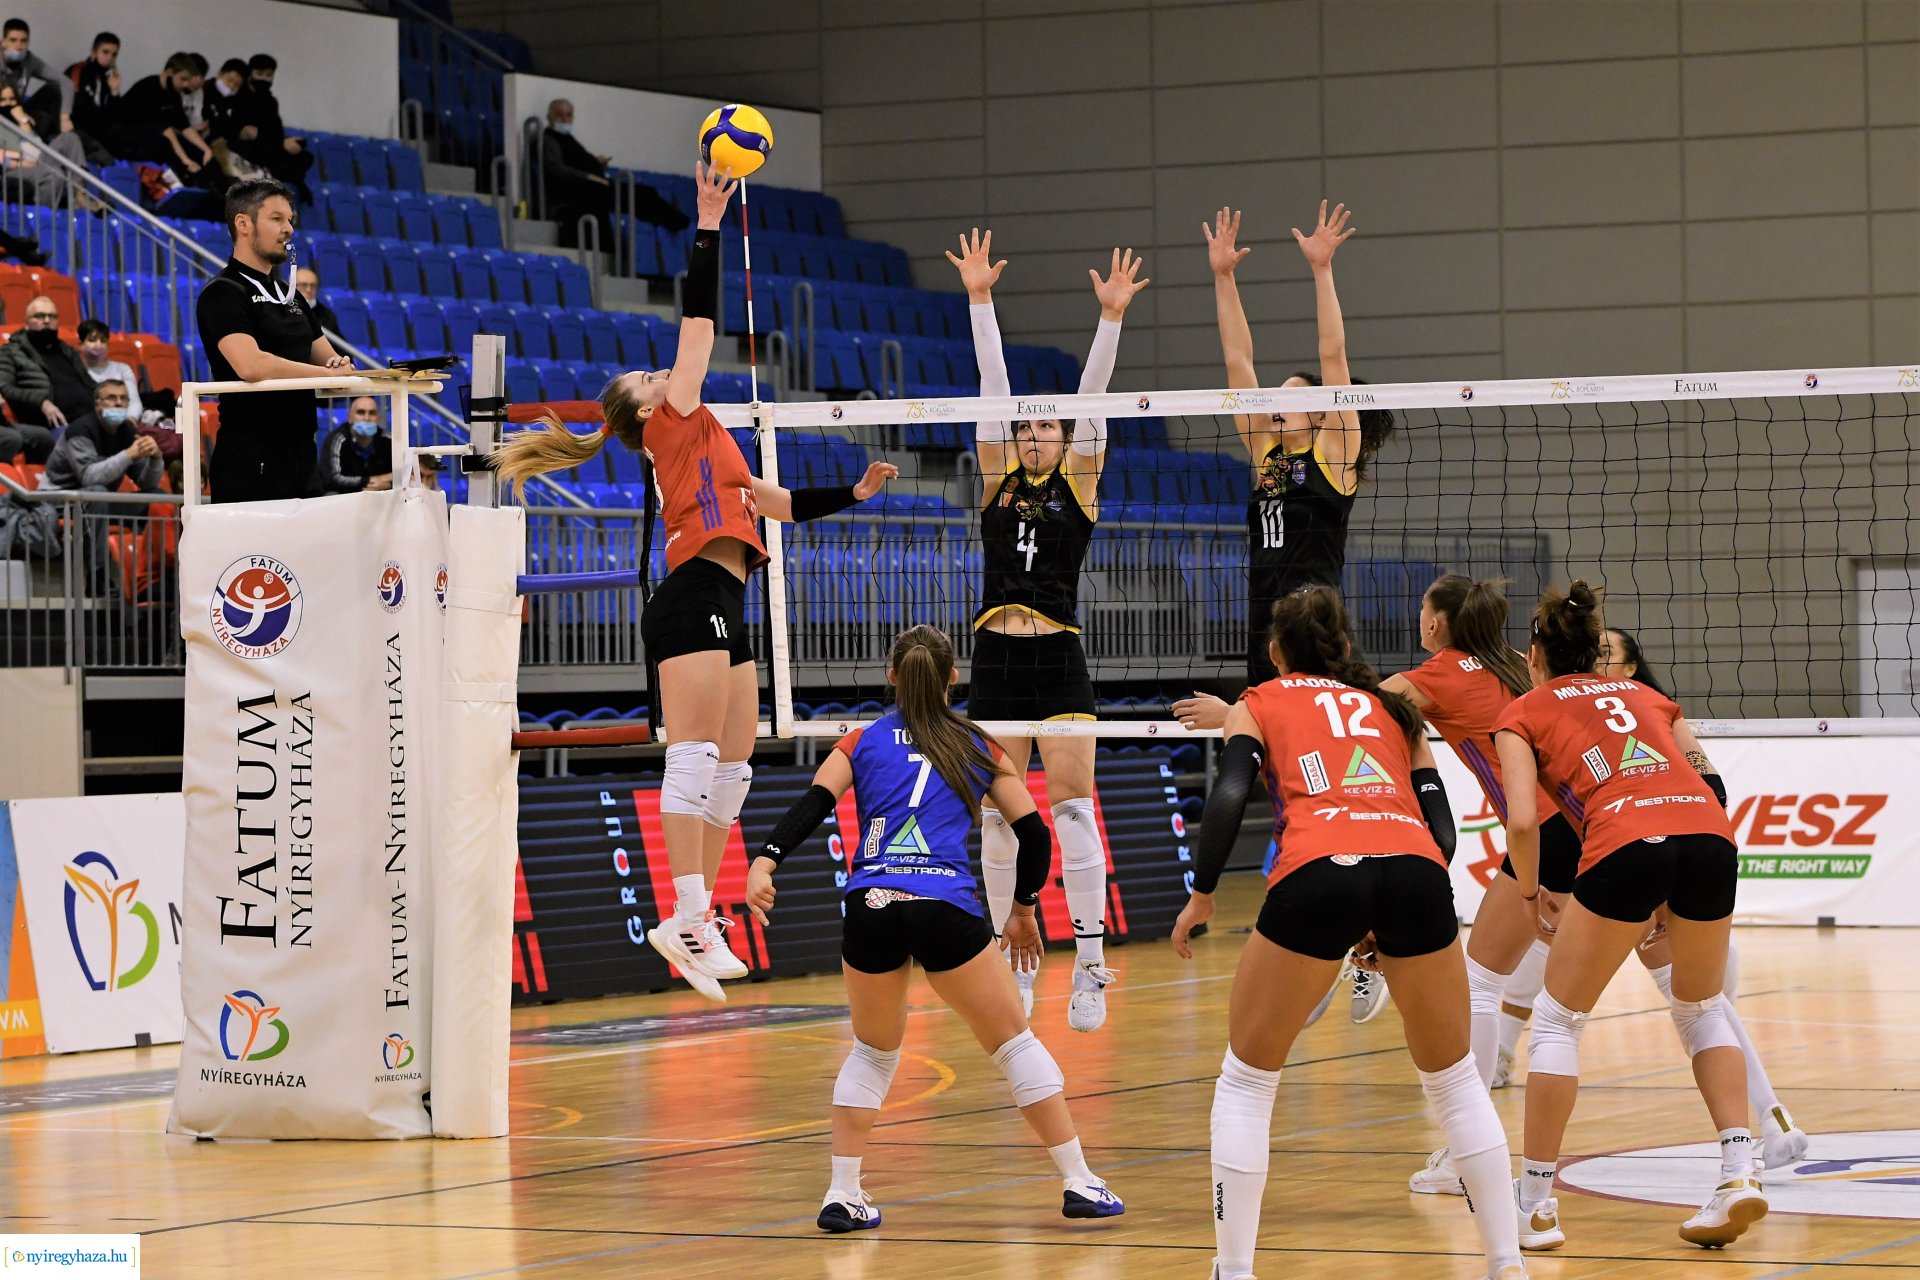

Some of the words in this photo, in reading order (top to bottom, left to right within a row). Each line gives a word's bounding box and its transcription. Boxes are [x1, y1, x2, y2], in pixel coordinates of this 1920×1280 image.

[1674, 379, 1718, 392] FATUM
[1016, 400, 1057, 414] FATUM
[1333, 391, 1376, 405] FATUM
[1259, 500, 1284, 548] 10
[1017, 522, 1038, 571] 4
[250, 557, 293, 586] FATUM
[211, 607, 290, 658] NYÍREGYHÁZA
[1458, 656, 1483, 673] BO
[1280, 678, 1352, 689] RADOS
[1553, 681, 1639, 700] MILANOVA
[1314, 692, 1380, 738] 12
[1595, 696, 1638, 734] 3
[1306, 756, 1324, 791] STRABAG
[1588, 751, 1608, 780] TRABAG
[1622, 765, 1657, 777] KE-VIZ
[1659, 763, 1670, 771] 21
[908, 754, 933, 807] 7
[1344, 786, 1382, 794] KE-VIZ
[1385, 786, 1396, 794] 21
[1634, 796, 1706, 807] BESTRONG
[216, 689, 279, 948] FATUM
[286, 690, 315, 949] NYÍREGYHÁZA
[1349, 812, 1424, 828] BESTRON
[600, 791, 645, 944] GROUP
[885, 867, 956, 877] BESTRONG
[1746, 859, 1778, 873] THE
[1779, 859, 1829, 873] RIGHT
[1830, 859, 1866, 873] WAY
[200, 1067, 306, 1088] NYÍREGYHÁZA
[375, 1071, 422, 1083] NYÍREGYHÁZA
